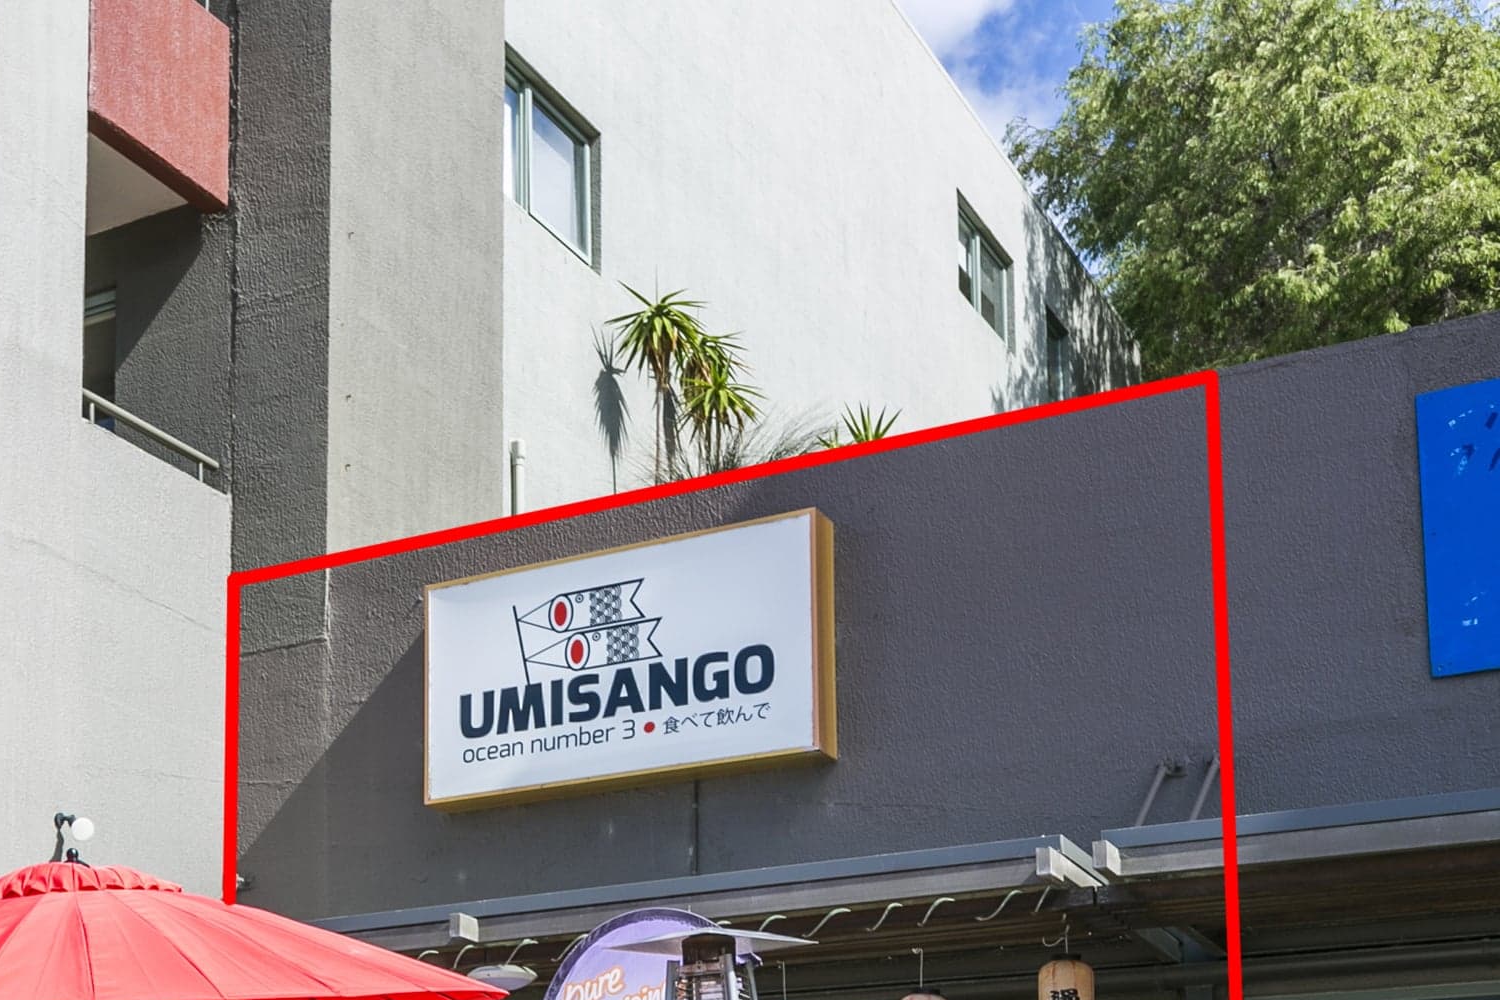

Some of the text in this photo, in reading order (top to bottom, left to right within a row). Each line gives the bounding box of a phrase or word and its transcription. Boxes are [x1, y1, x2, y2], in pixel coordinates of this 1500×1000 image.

[460, 644, 775, 738] UMISANGO
[663, 702, 772, 735] 食べて飲んで
[462, 719, 636, 764] ocean number 3
